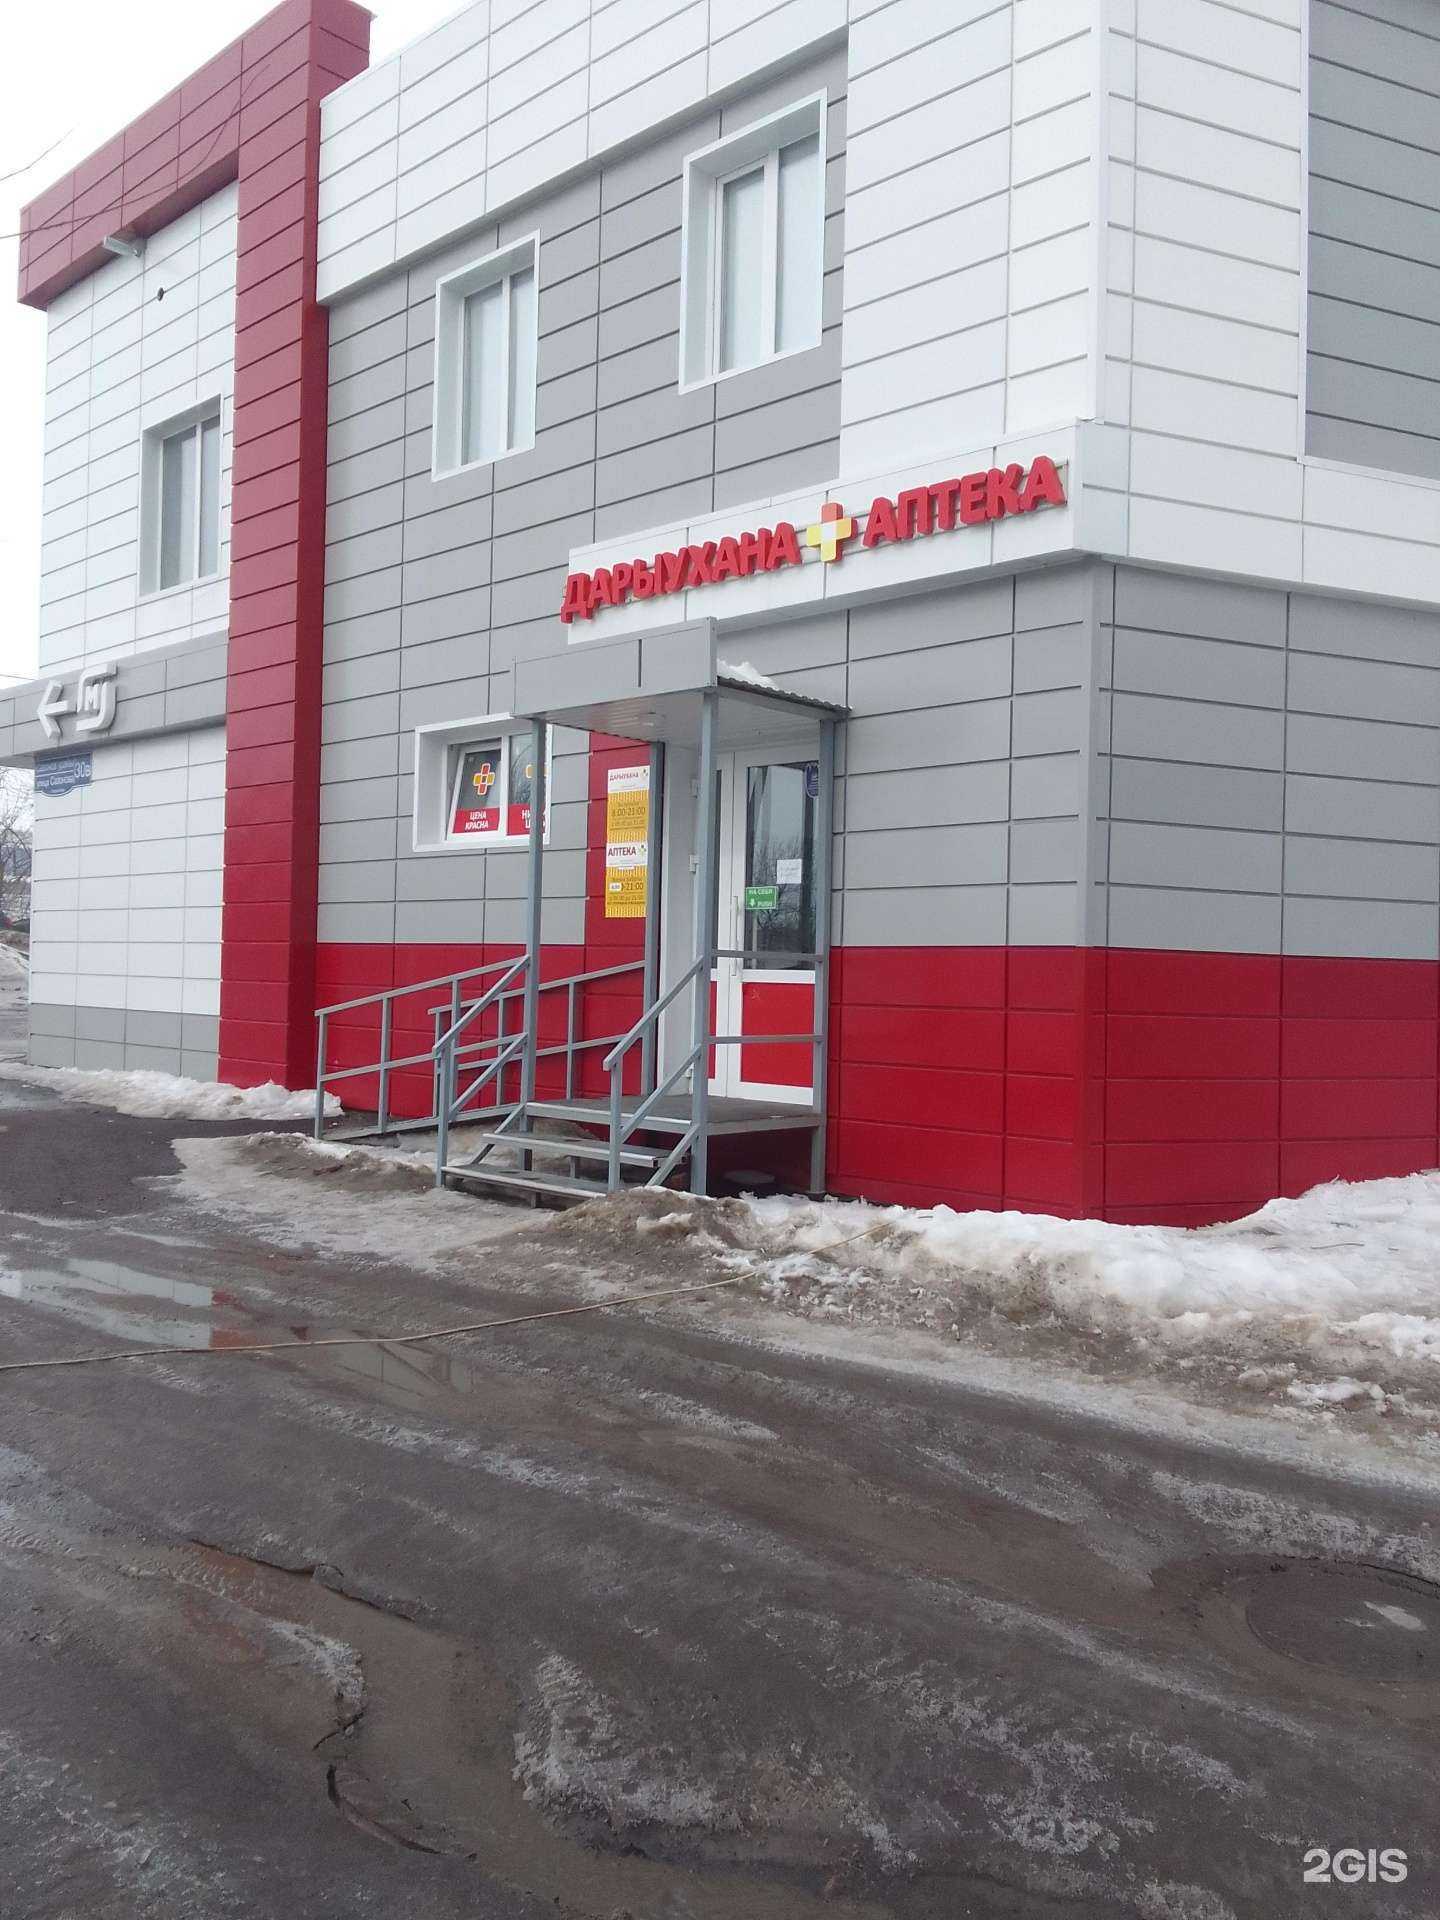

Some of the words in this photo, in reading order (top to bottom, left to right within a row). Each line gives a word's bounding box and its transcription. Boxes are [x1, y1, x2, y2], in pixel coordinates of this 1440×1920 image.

[561, 522, 802, 623] ДАРЫУХАНА
[862, 455, 1068, 547] АПТЕКА
[470, 811, 487, 821] ЦЕНА
[465, 820, 489, 831] КРАСНА
[608, 846, 637, 857] АПТЕКА
